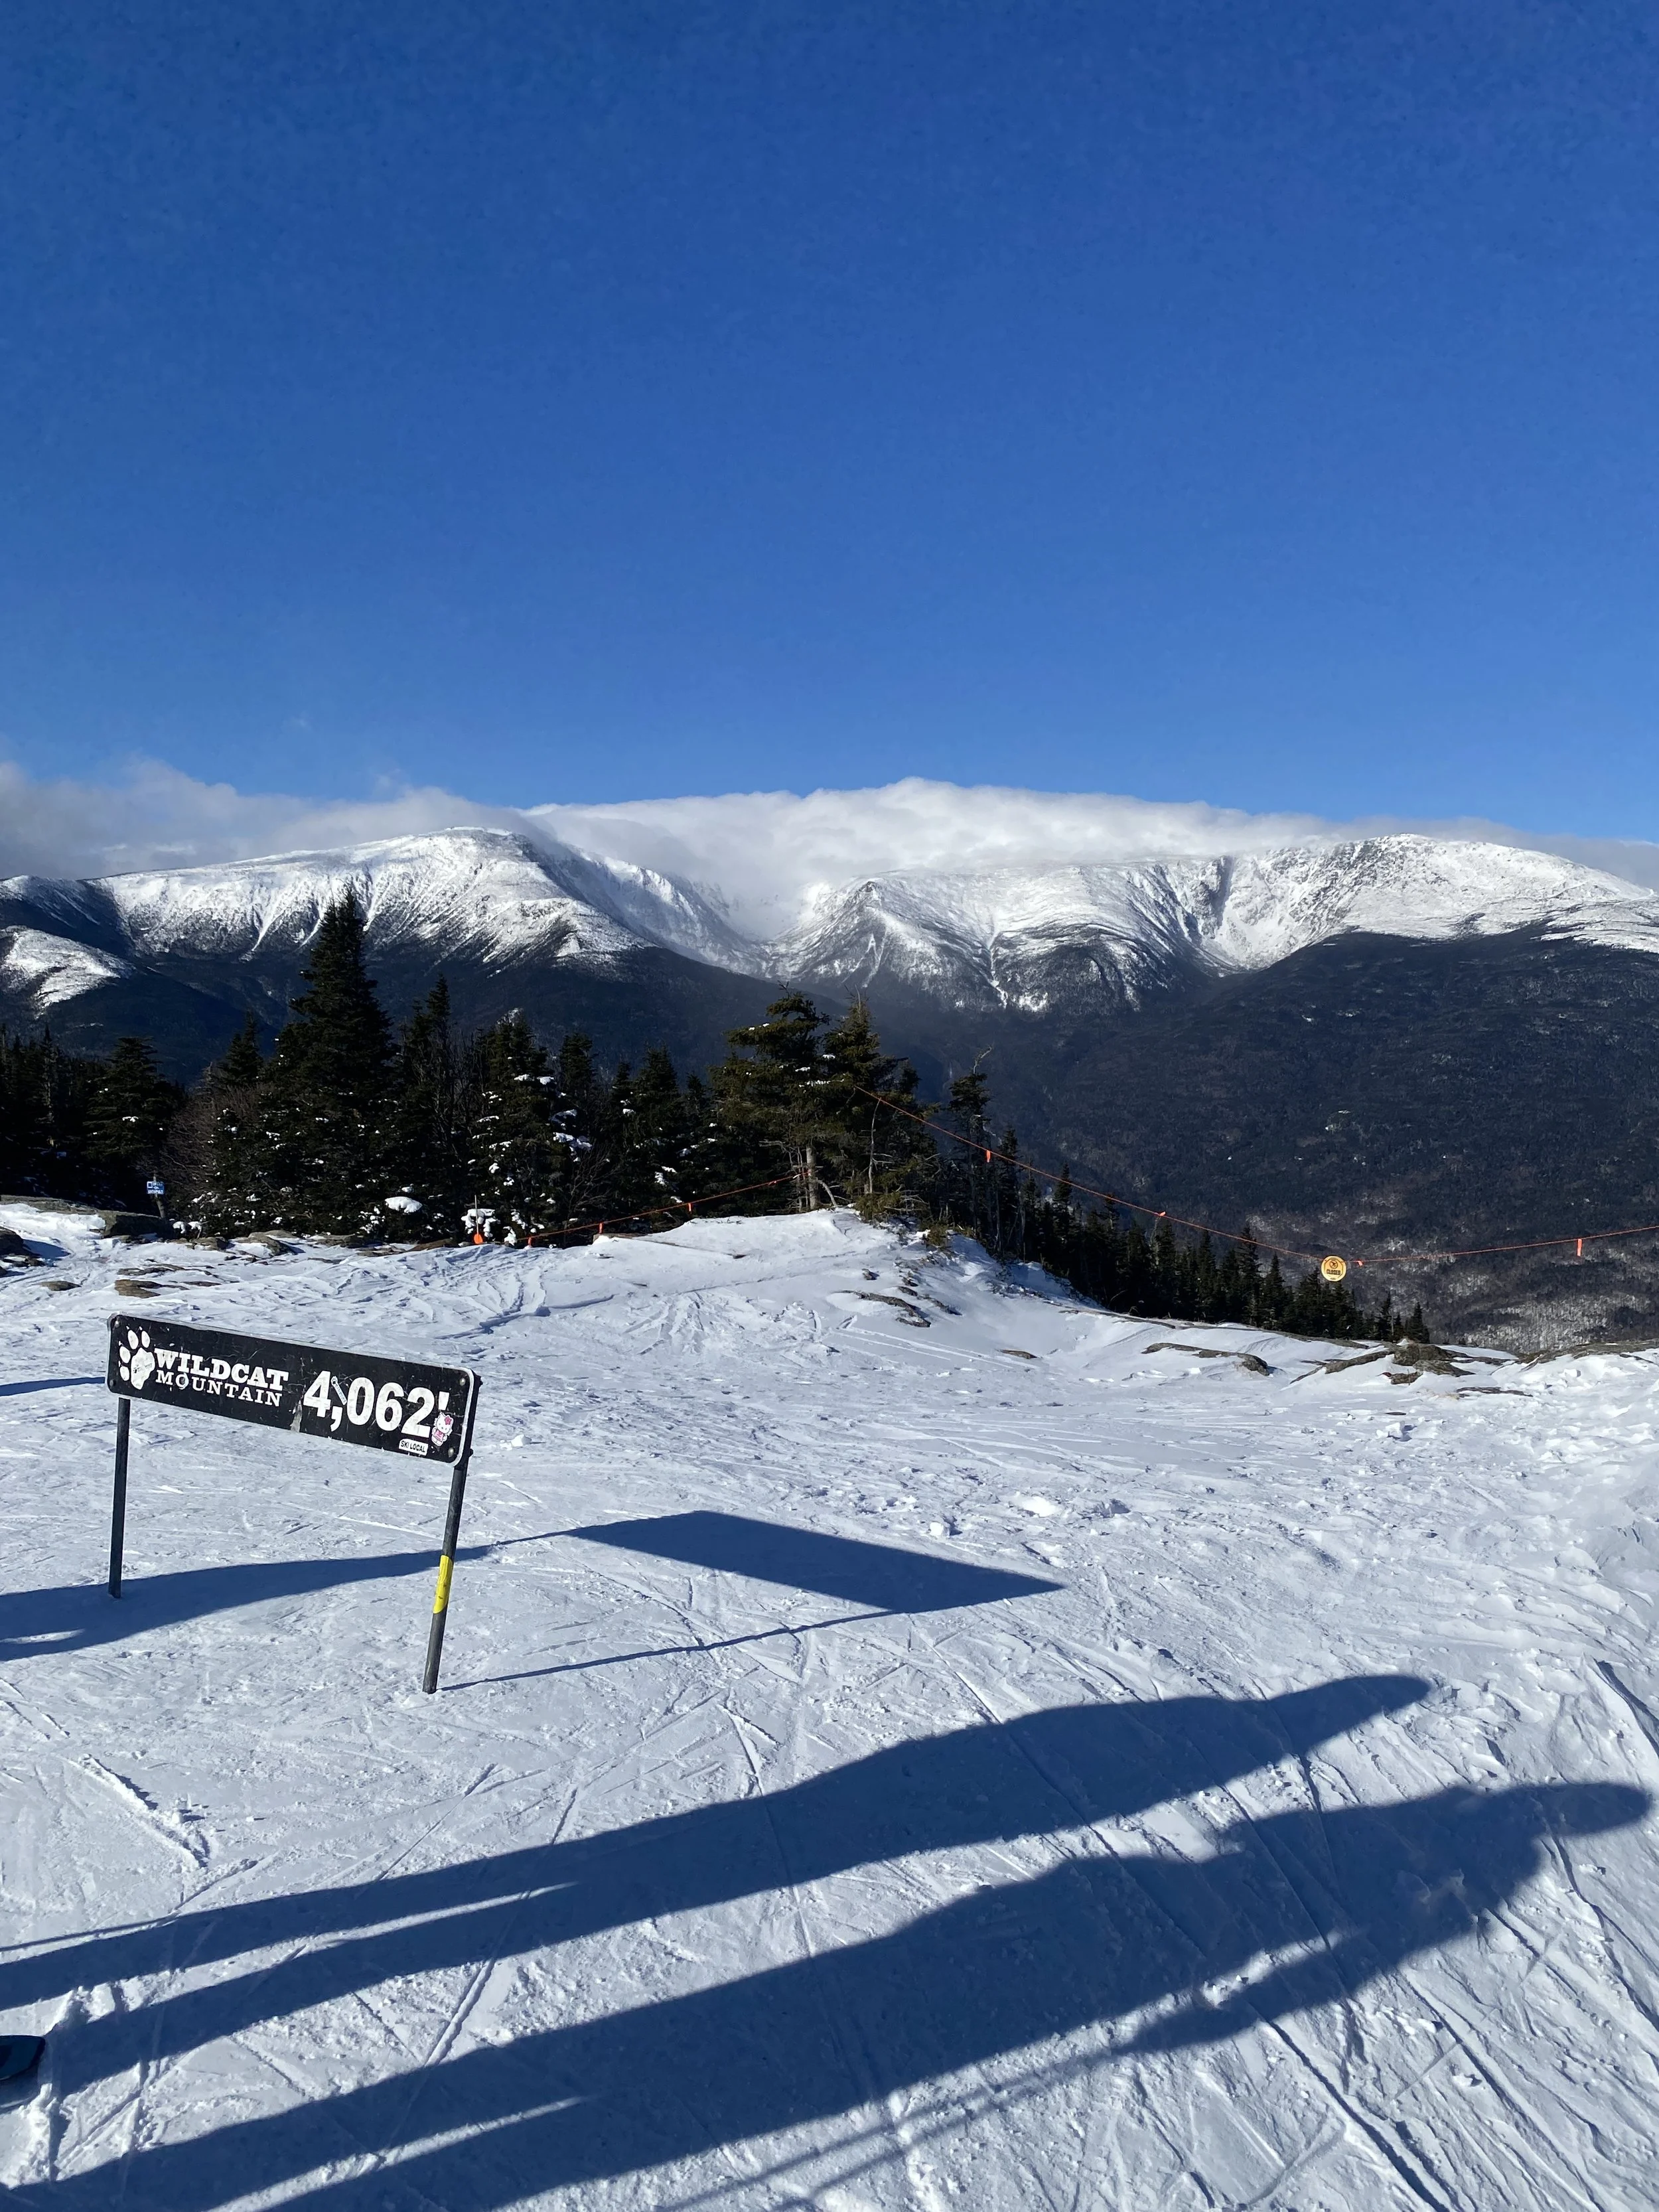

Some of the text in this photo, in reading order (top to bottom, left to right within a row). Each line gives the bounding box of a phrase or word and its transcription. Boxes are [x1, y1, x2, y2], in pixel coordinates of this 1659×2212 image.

[154, 1348, 289, 1391] WILDCAT
[155, 1369, 282, 1406] MOUNTAIN
[303, 1370, 449, 1438] 4,062'
[410, 1443, 425, 1453] LOCAL
